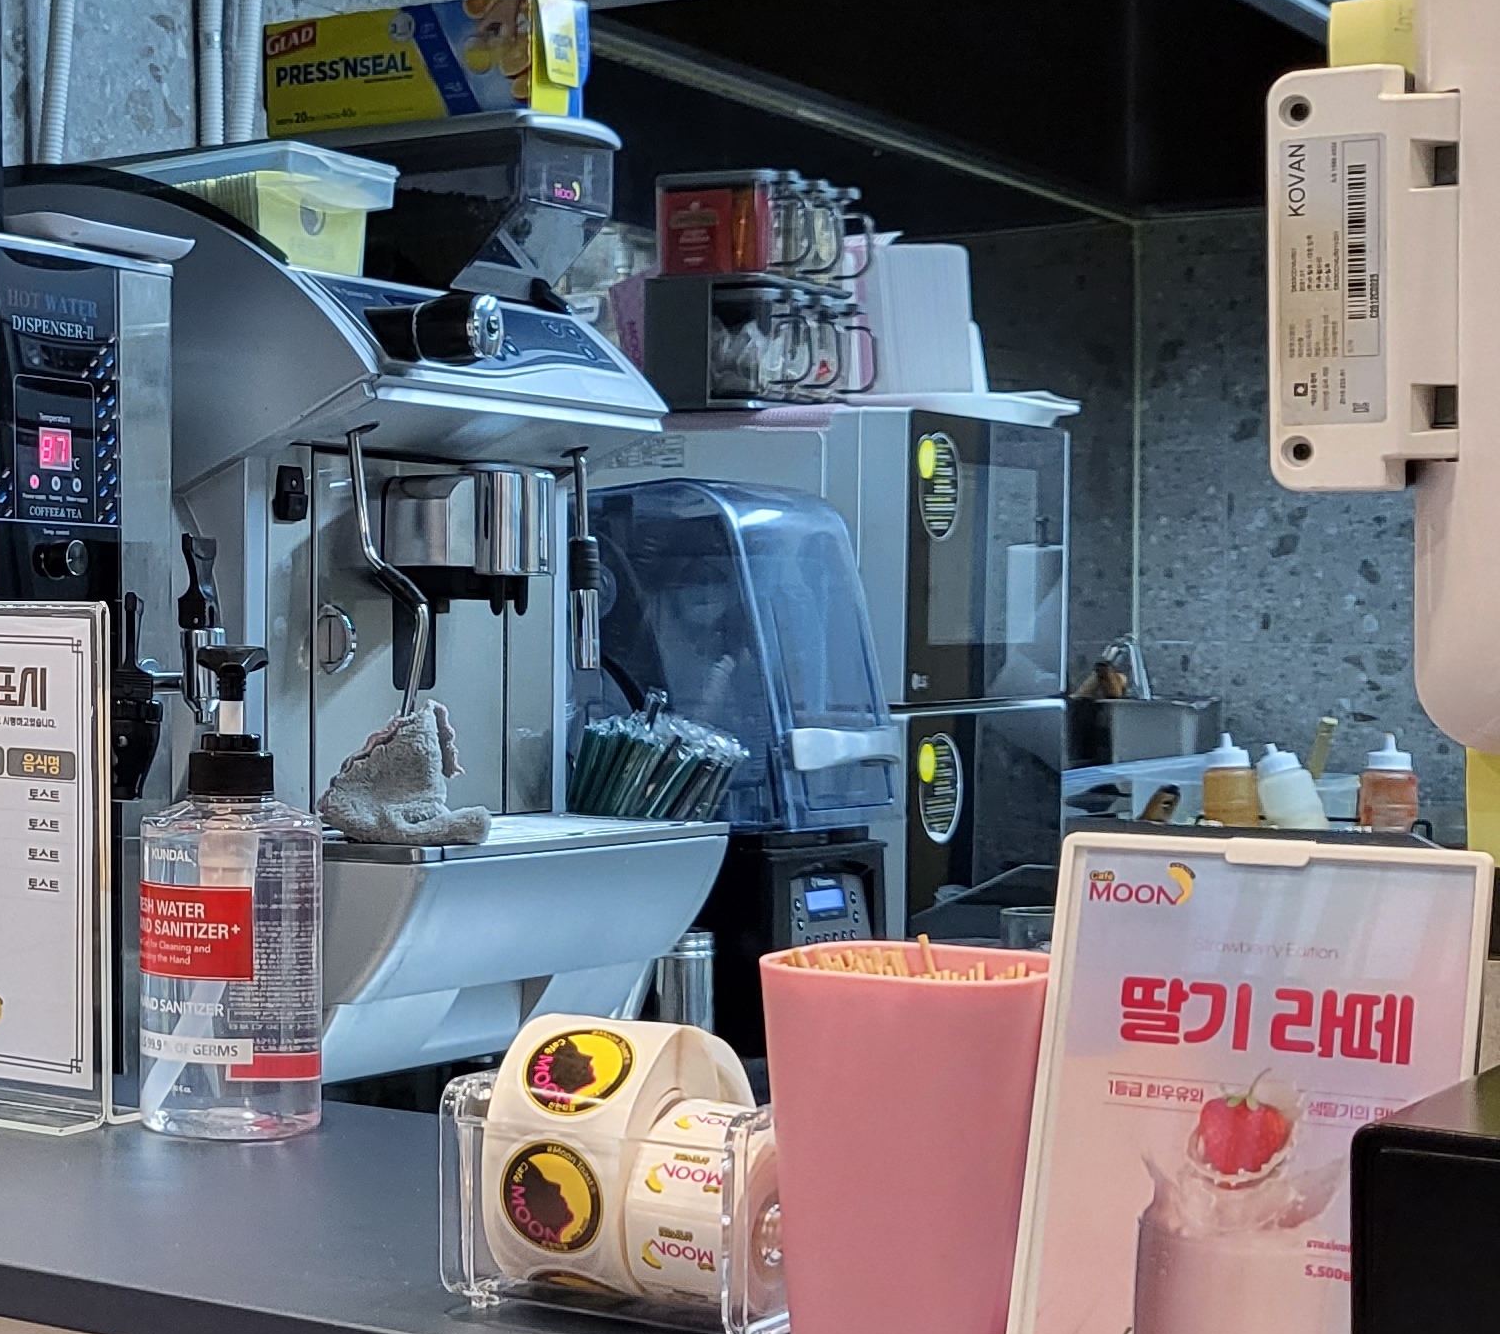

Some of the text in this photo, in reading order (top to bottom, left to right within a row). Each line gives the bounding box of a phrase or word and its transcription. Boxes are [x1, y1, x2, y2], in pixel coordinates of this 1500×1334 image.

[266, 26, 314, 56] GLAD
[1287, 142, 1306, 219] KOVAN
[45, 294, 98, 319] WATER
[22, 753, 60, 775] 음식명
[28, 788, 60, 803] 토스트
[28, 878, 60, 892] 토스트
[1088, 882, 1180, 906] MOON
[157, 900, 205, 919] WATER
[159, 941, 211, 954] Cleaning and
[160, 998, 225, 1017] SANITIZER
[1119, 975, 1415, 1066] 딸기 라떼
[193, 1044, 239, 1057] GERMS
[650, 1239, 714, 1265] MOON
